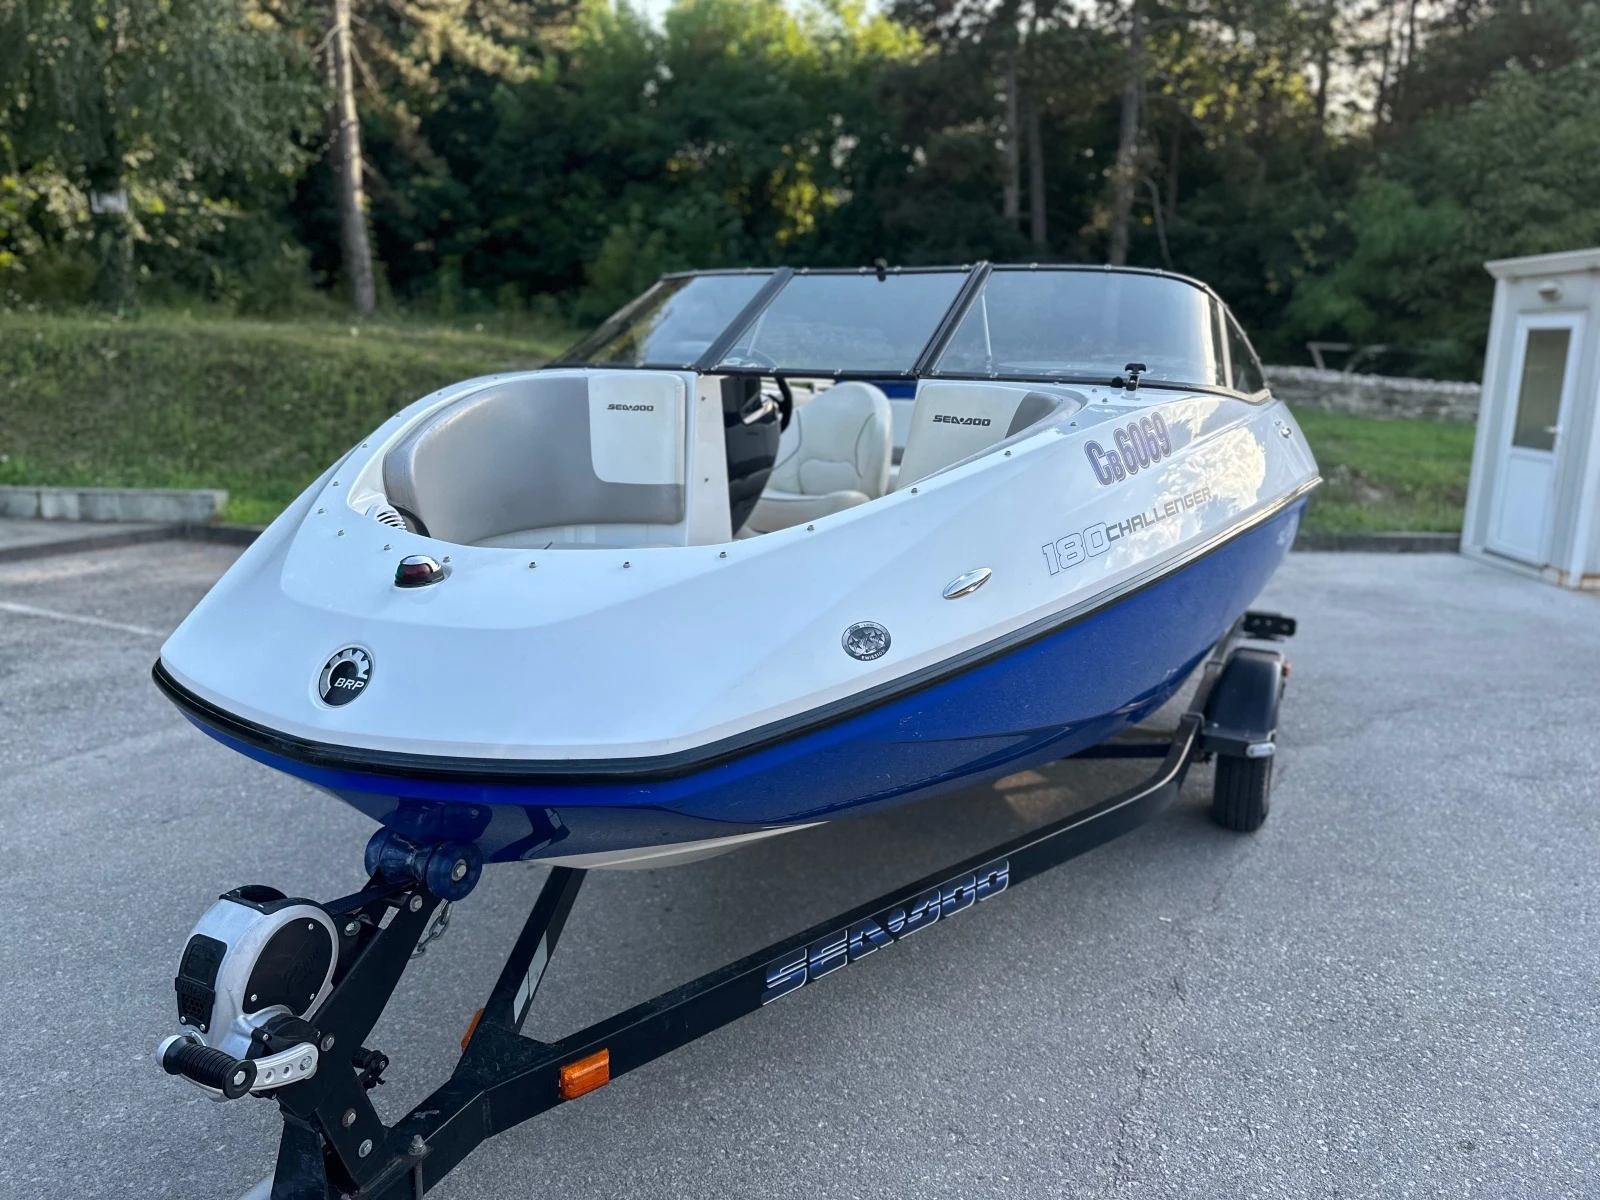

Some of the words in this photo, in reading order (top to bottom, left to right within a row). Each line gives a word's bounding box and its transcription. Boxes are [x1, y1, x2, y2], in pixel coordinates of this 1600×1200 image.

[1041, 521, 1112, 576] 180
[1105, 486, 1213, 543] CHALLENGER
[334, 677, 365, 690] BRP
